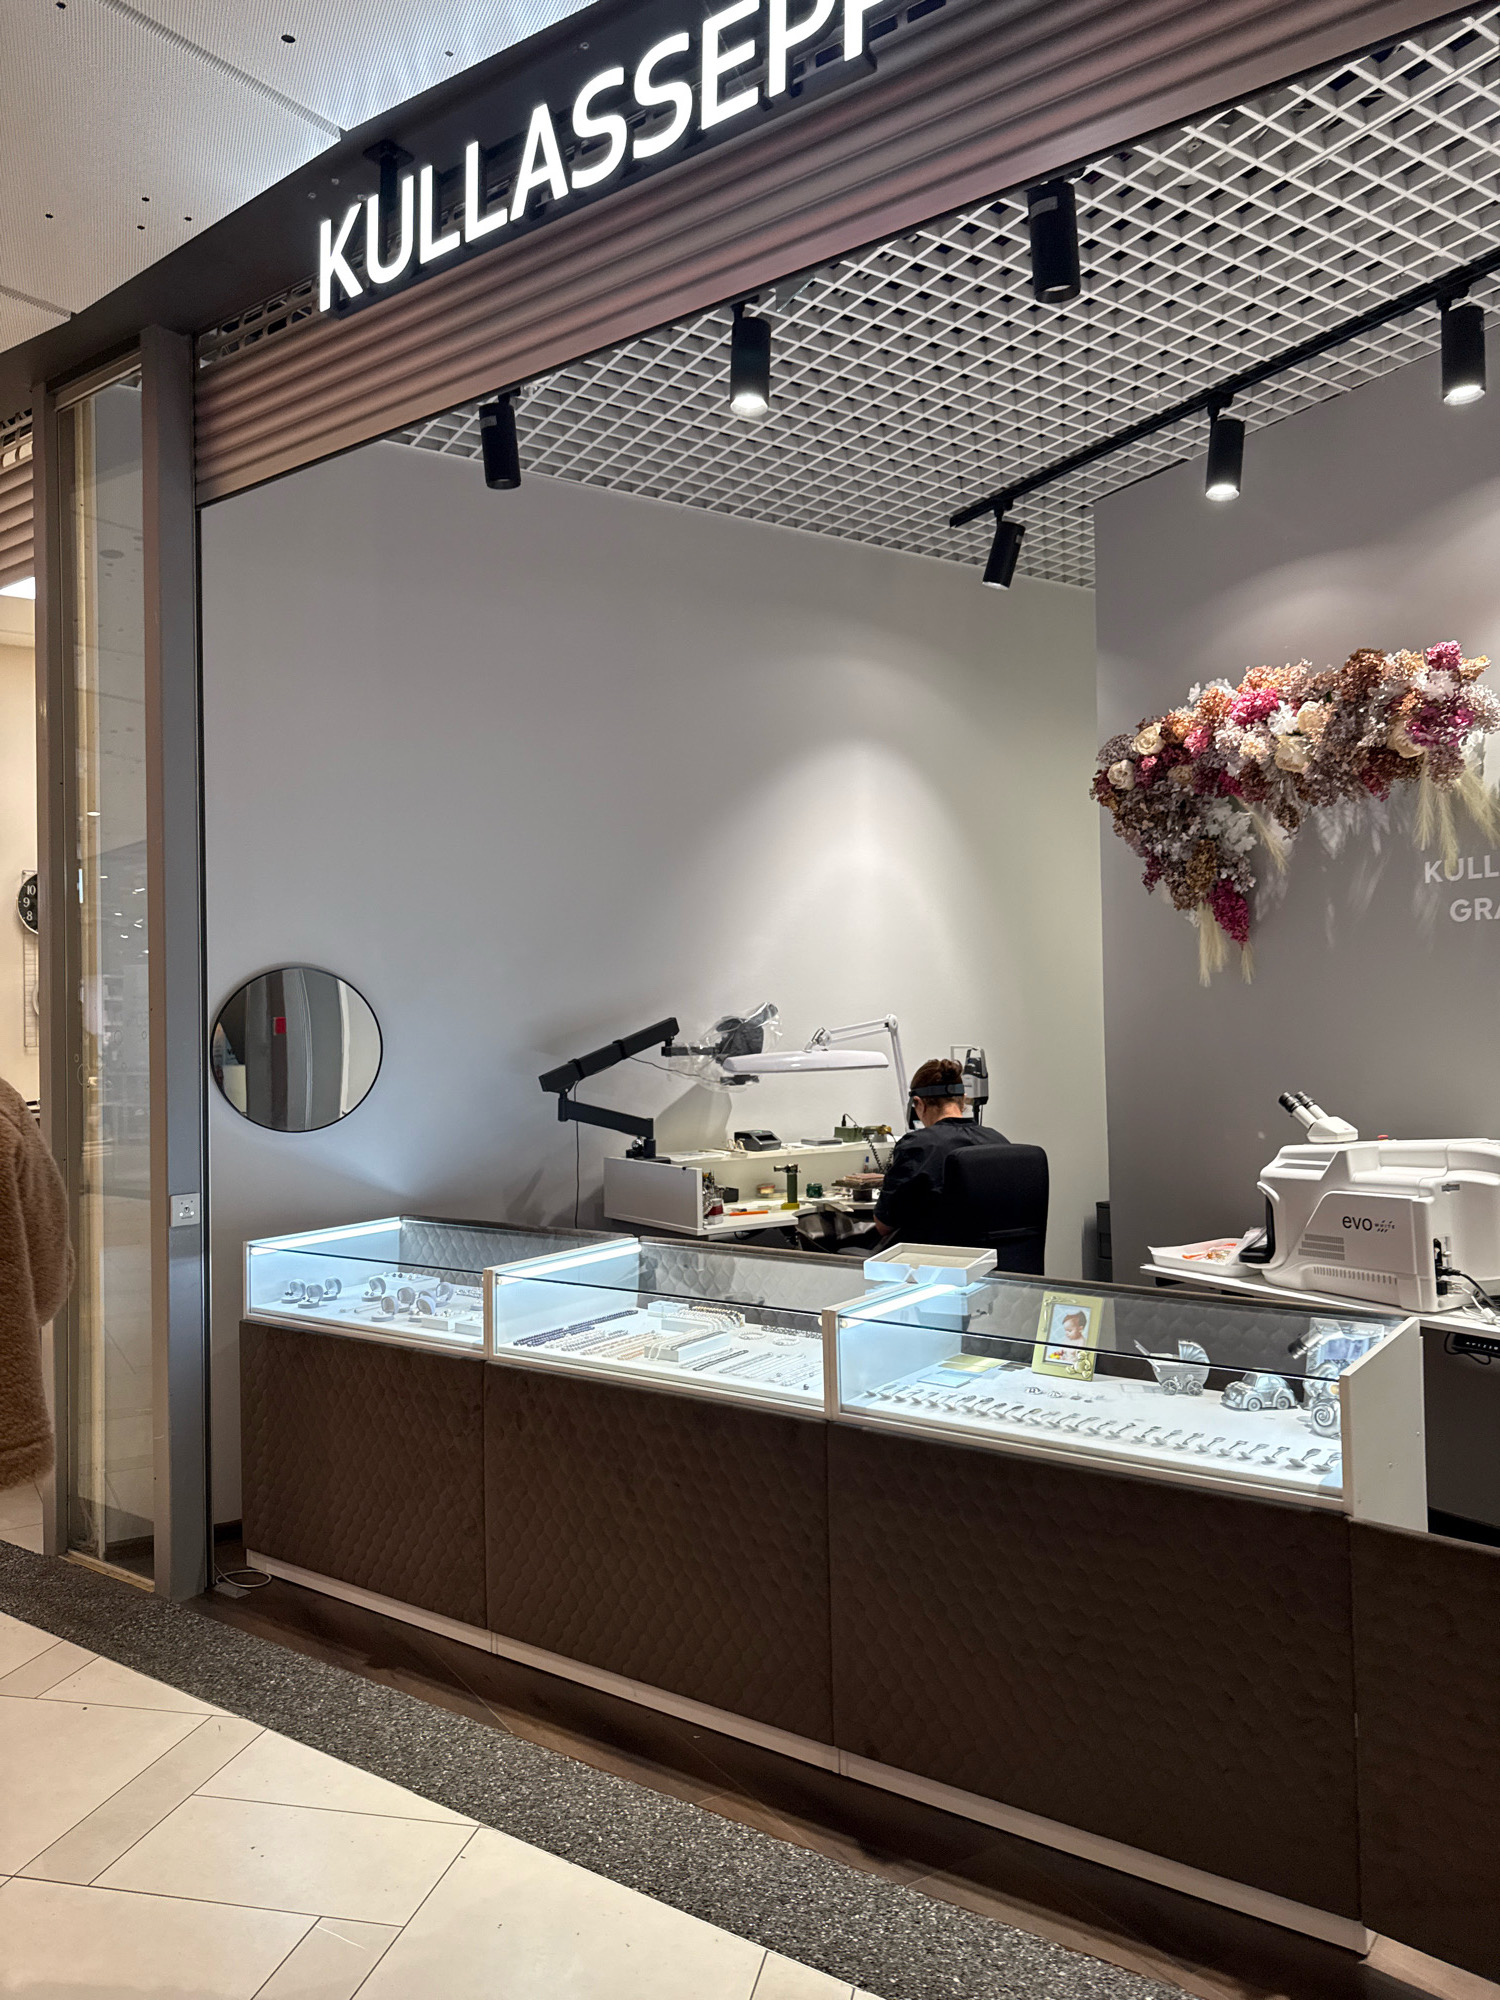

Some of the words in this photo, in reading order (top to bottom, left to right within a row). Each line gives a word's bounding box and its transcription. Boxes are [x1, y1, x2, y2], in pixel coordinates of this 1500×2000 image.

[27, 884, 36, 896] 10
[23, 897, 31, 908] 9
[26, 910, 33, 921] 8
[1449, 897, 1500, 922] GR
[1342, 1215, 1373, 1231] evo
